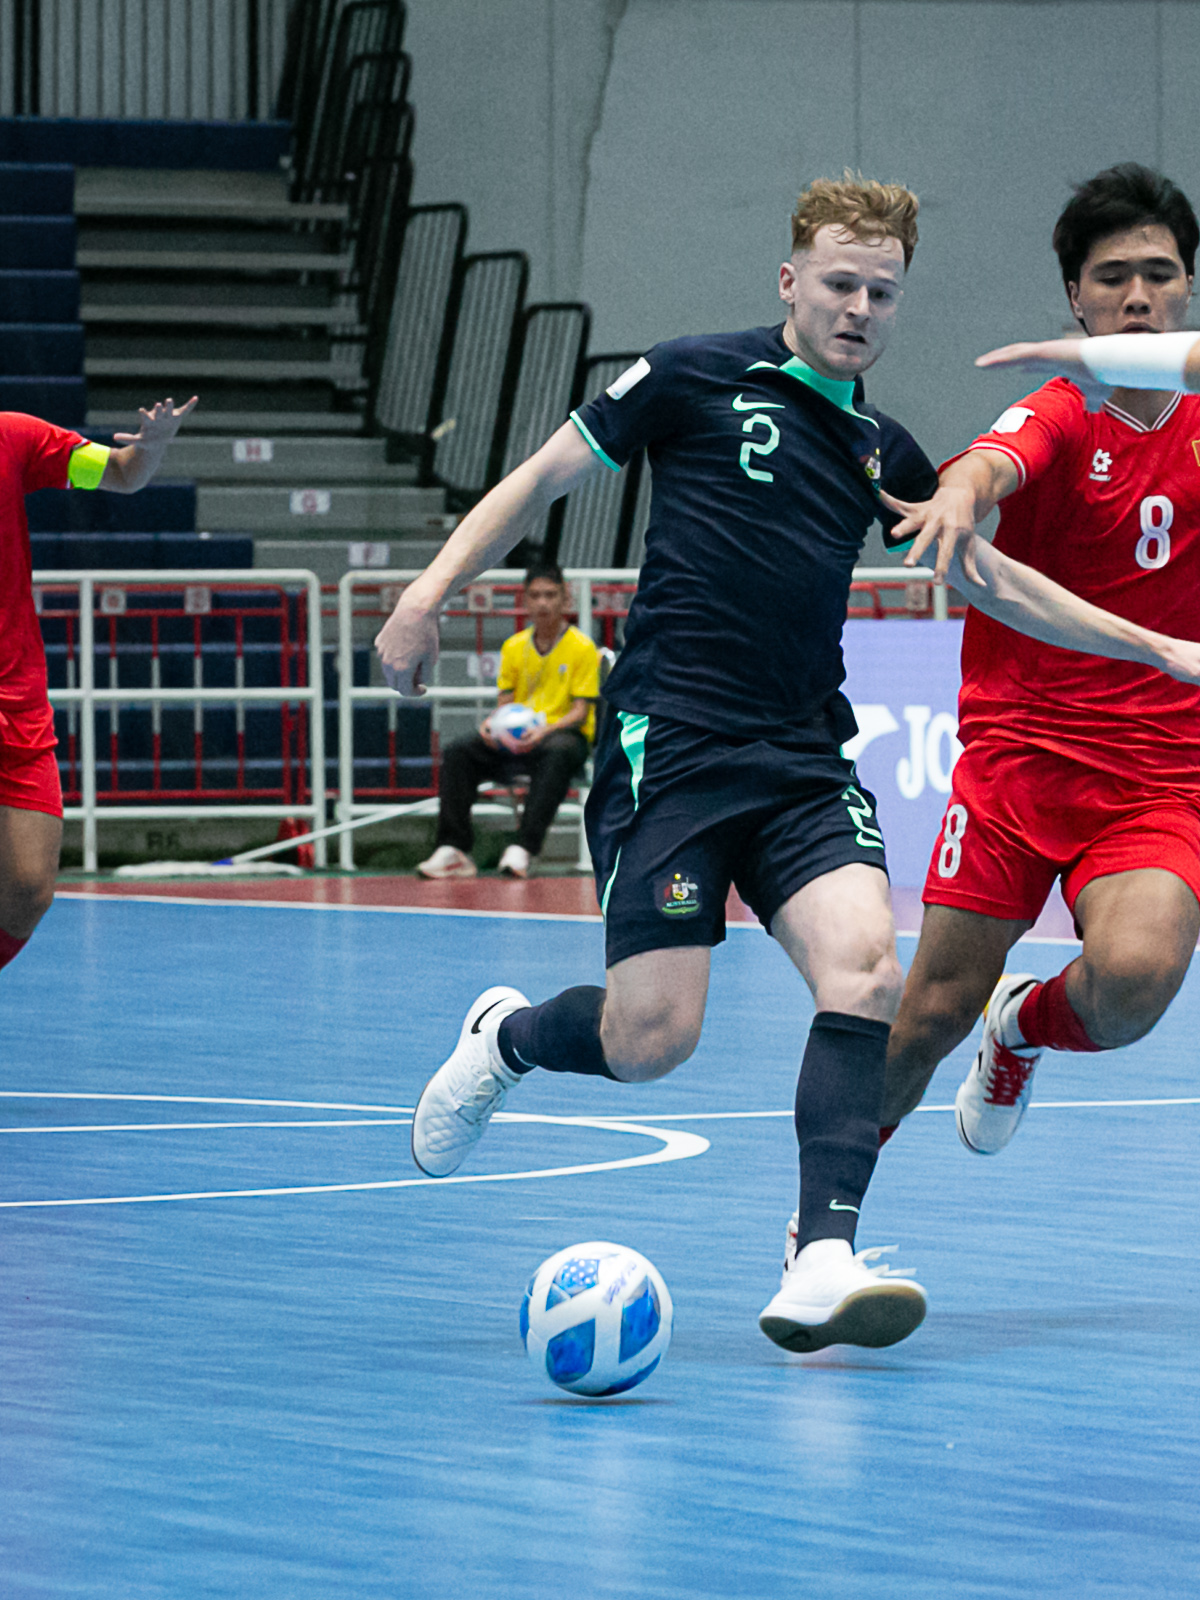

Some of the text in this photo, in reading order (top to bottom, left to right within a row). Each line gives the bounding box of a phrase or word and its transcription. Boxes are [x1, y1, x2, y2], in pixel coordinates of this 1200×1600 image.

[739, 413, 780, 483] 2
[1135, 495, 1174, 569] 8
[841, 785, 883, 842] 2
[938, 803, 968, 878] 8
